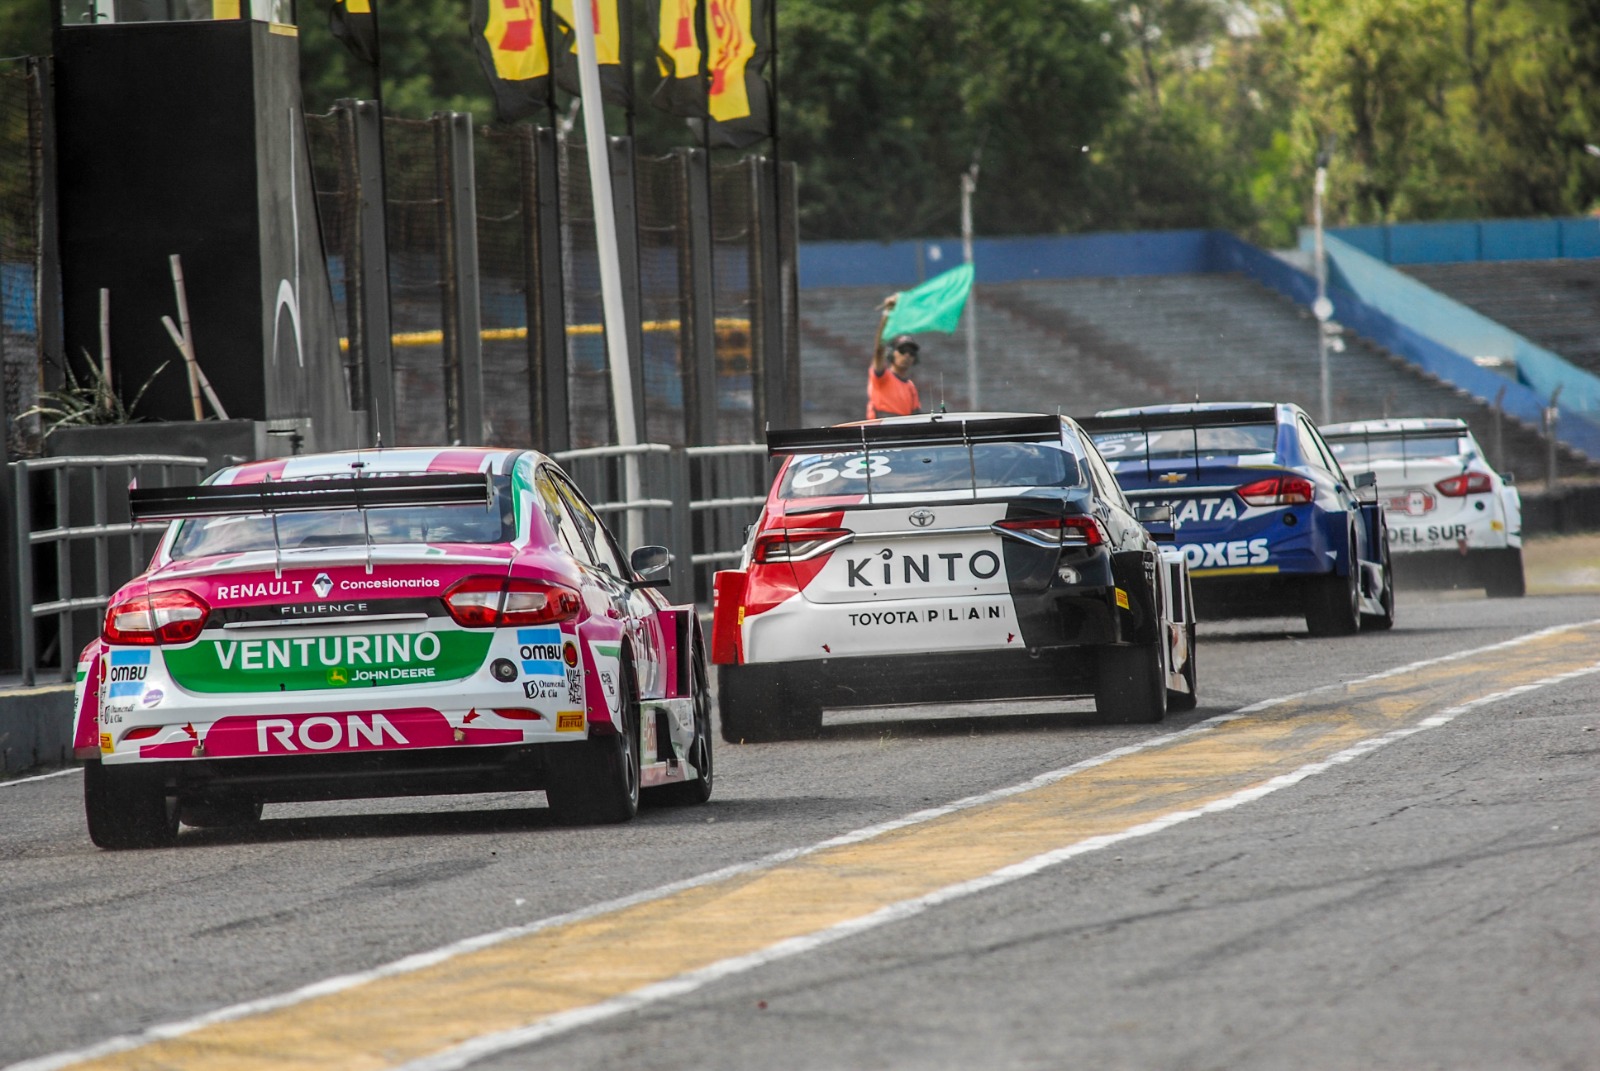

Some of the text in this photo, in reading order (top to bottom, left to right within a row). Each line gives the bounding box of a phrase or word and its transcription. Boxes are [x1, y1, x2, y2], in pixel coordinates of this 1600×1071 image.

[1097, 434, 1162, 456] 57
[792, 455, 892, 489] 68
[1428, 524, 1467, 540] SUR
[217, 577, 440, 600] RENAULT Concesionarios
[281, 603, 368, 615] FLUENCE
[849, 611, 918, 626] TOYOTA
[213, 631, 441, 670] VENTURINO
[520, 645, 561, 660] OMBU
[111, 666, 148, 681] OMBU
[351, 667, 436, 681] JOHN DEERE
[256, 713, 410, 752] ROM
